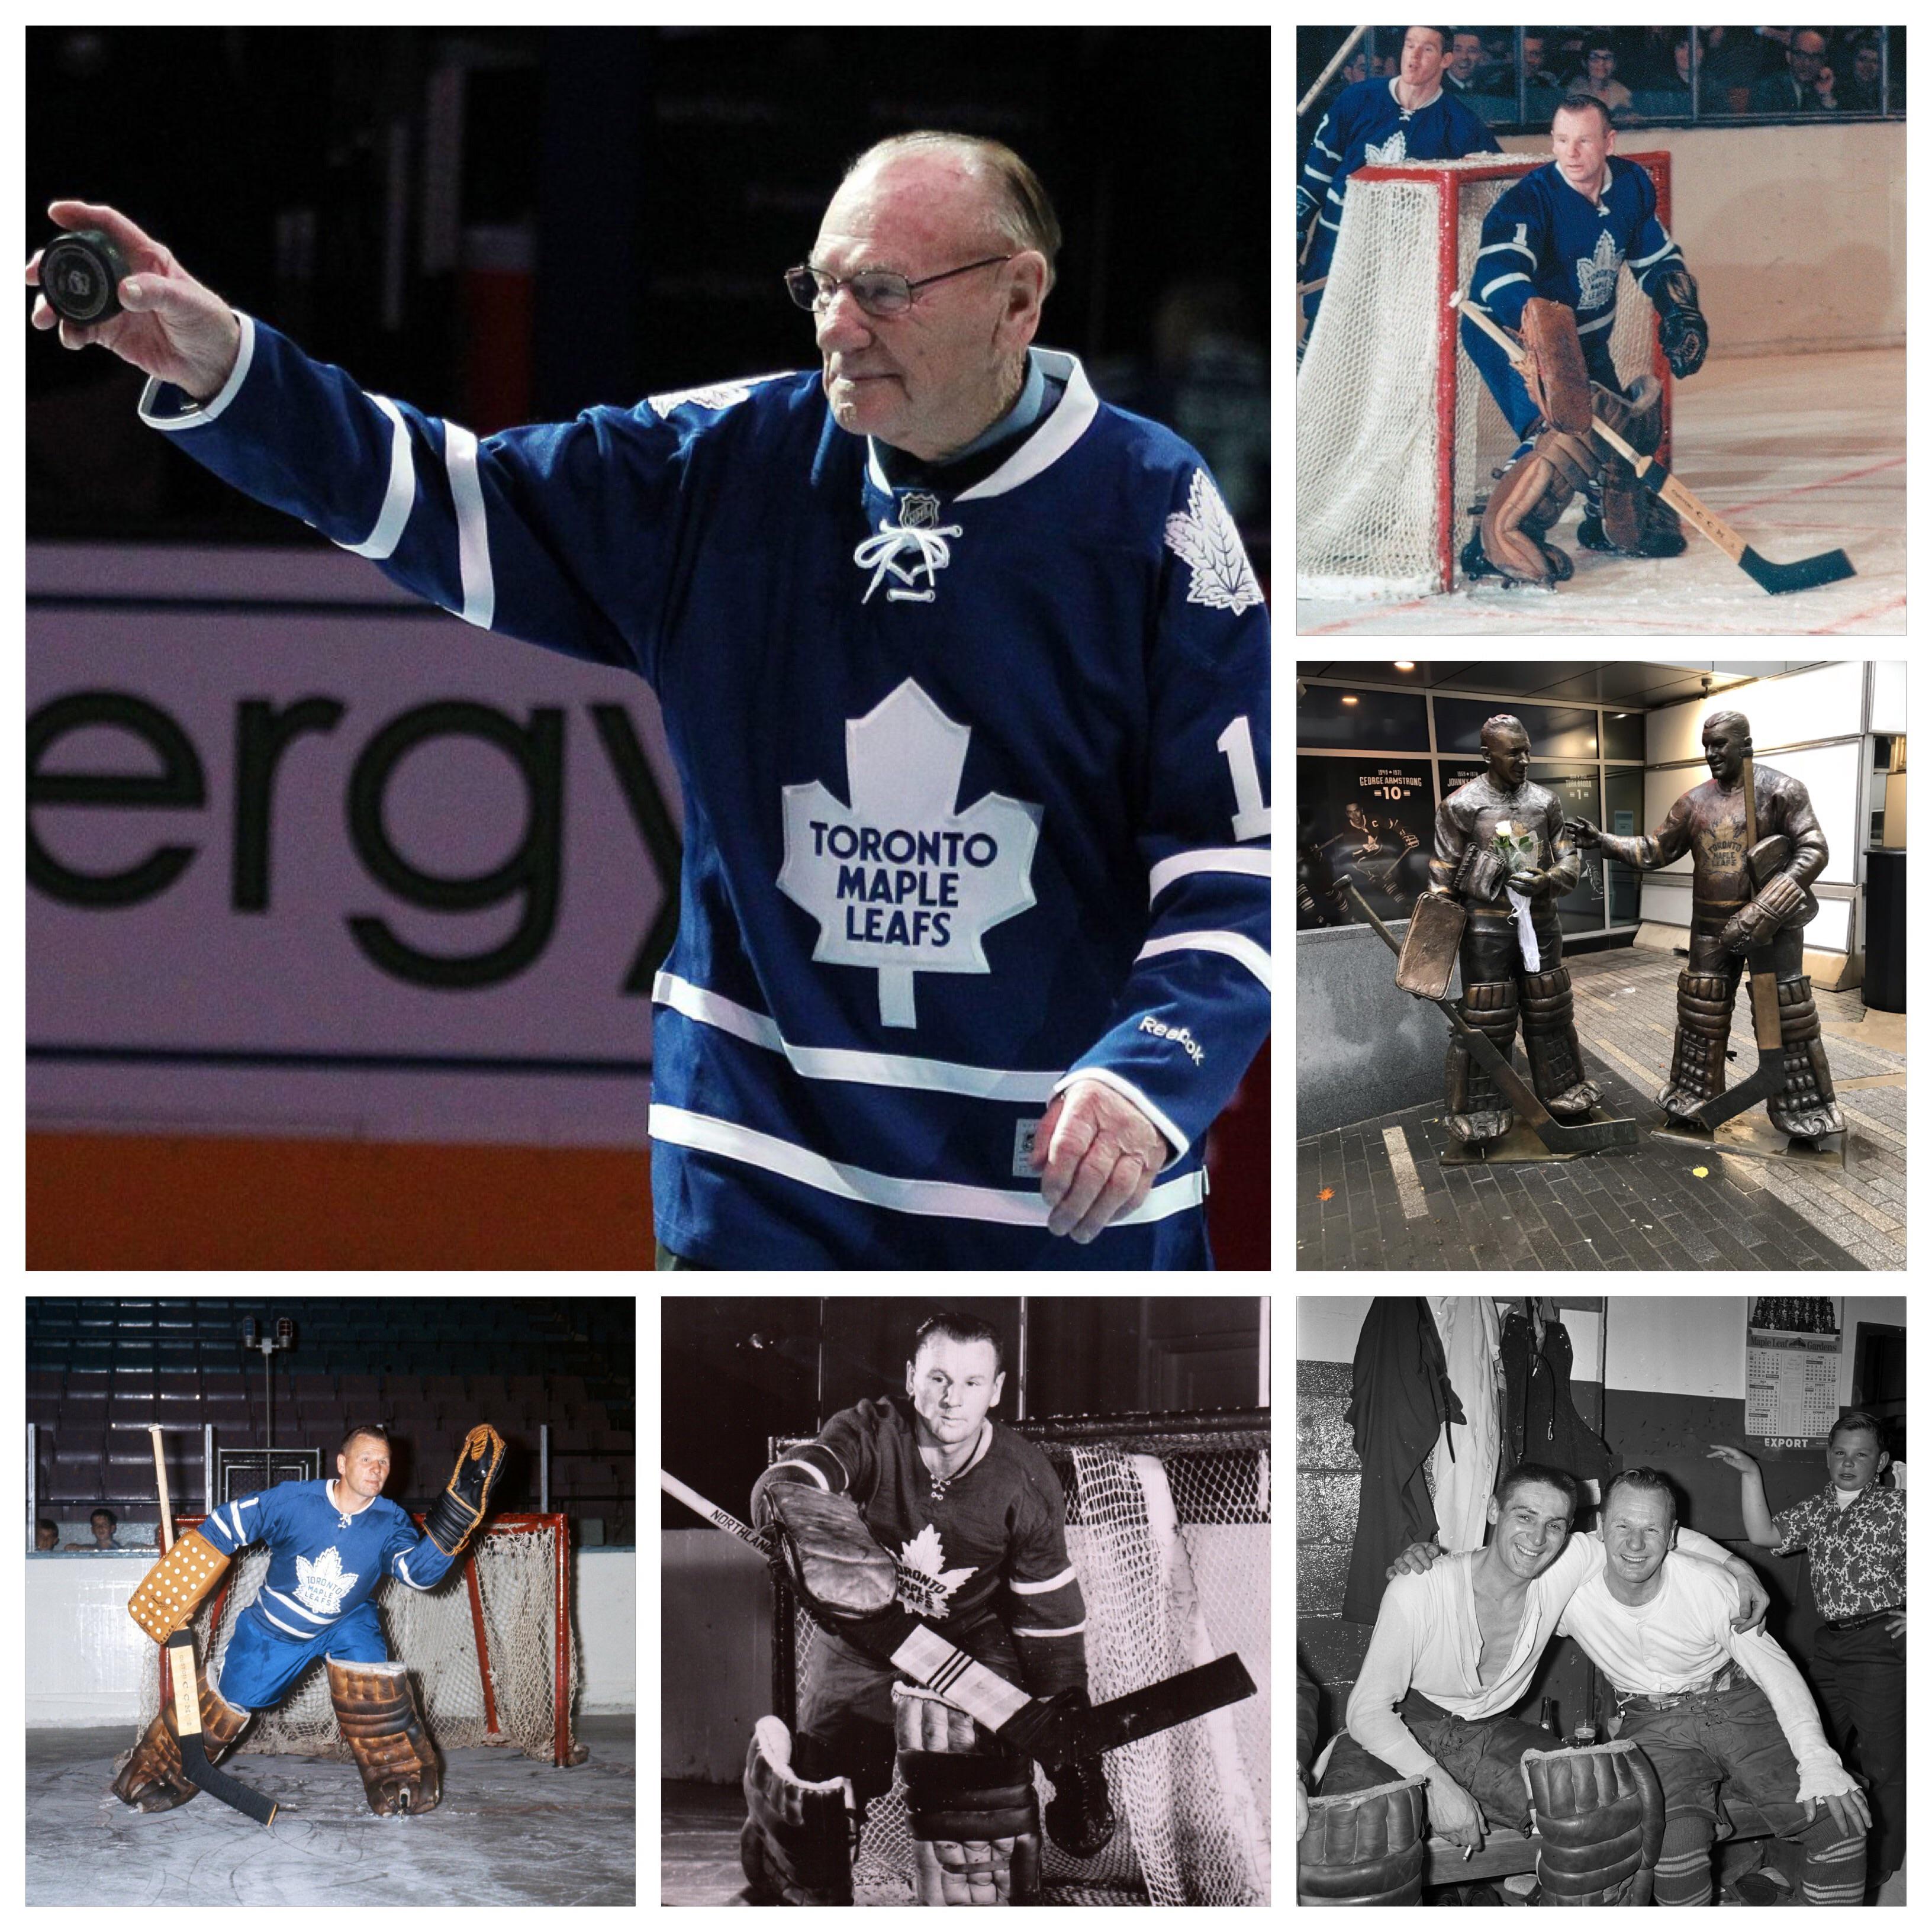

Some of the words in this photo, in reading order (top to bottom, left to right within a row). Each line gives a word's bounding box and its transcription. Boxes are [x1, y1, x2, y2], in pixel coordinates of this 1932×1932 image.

[1512, 223, 1527, 247] 1
[1217, 716, 1271, 842] 1
[1360, 777, 1384, 787] GEORGE
[1384, 777, 1422, 787] ARMSTRONG
[1383, 786, 1401, 800] 10
[1576, 789, 1582, 800] 1
[25, 688, 684, 997] ergy
[810, 820, 997, 868] TORONTO
[1708, 841, 1742, 853] TORONTO
[836, 865, 959, 908] MAPLE
[846, 905, 951, 948] LEAFS
[1138, 1016, 1205, 1066] Reebok
[1751, 1336, 1772, 1348] Maple
[1772, 1338, 1789, 1348] Leaf
[1807, 1341, 1837, 1351] Gardens
[1764, 1438, 1808, 1448] EXPORT
[239, 1497, 259, 1509] 1
[307, 1576, 342, 1595] TORONTO
[897, 1564, 947, 1594] ORONTO
[305, 1591, 331, 1606] LEAFS
[308, 1585, 333, 1599] MAPLE
[899, 1586, 934, 1609] EAFS
